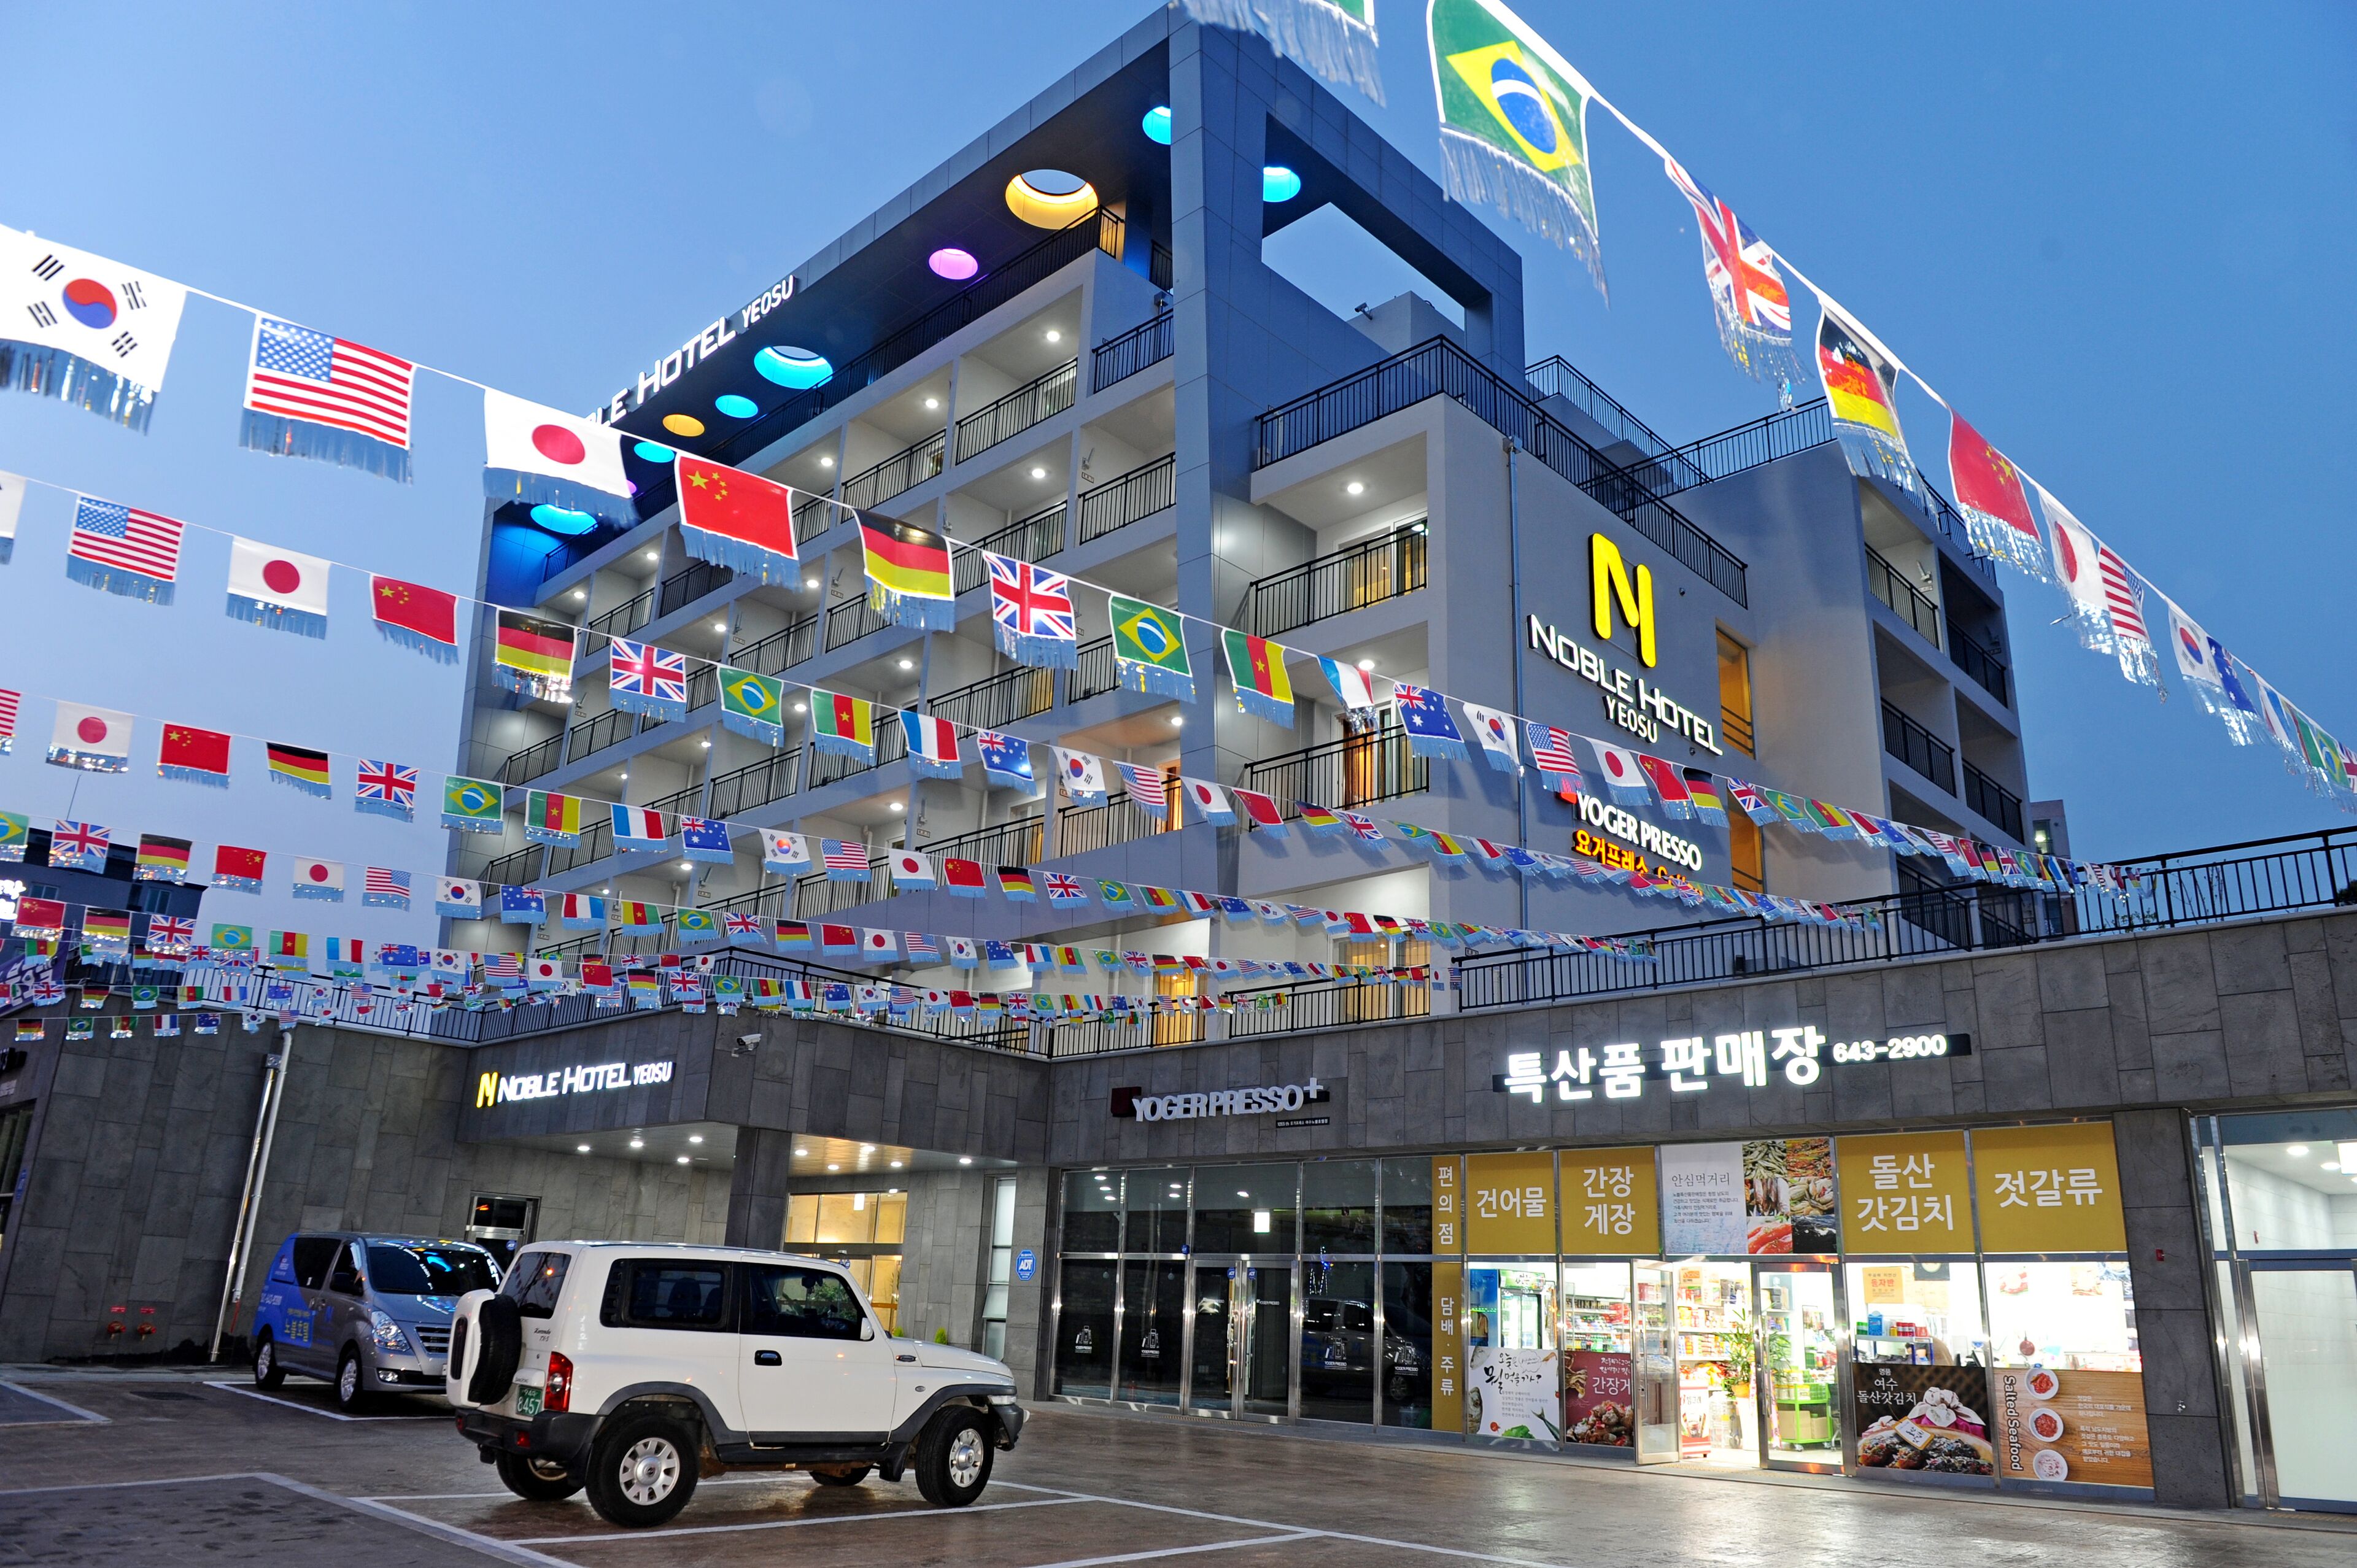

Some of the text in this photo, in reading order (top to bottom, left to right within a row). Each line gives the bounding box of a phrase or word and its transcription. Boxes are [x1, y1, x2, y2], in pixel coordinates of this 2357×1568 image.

[637, 315, 737, 404] HOTEL
[742, 274, 795, 328] YEOSU
[1528, 614, 1723, 755] NOBLE HOTEL
[1604, 695, 1658, 743] YEOSU
[1574, 829, 1649, 874] 요거프레소
[497, 1072, 561, 1103] NOBLE
[562, 1062, 632, 1095] HOTEL
[633, 1061, 673, 1086] YEOSU
[1504, 1025, 1948, 1103] 특산품 판매장 643-2900
[1583, 1166, 1634, 1197] 간장
[1671, 1172, 1730, 1187] 안심먹거리
[1869, 1153, 1935, 1190] 돌산
[1994, 1168, 2103, 1208] 젓갈류
[1438, 1167, 1453, 1245] 편의점
[1477, 1187, 1547, 1218] 건어물
[1584, 1203, 1636, 1235] 게장
[1857, 1194, 1954, 1232] 갓김치
[1019, 1259, 1033, 1270] ADT
[1499, 1353, 1518, 1370] 오늘은
[1504, 1372, 1542, 1386] 먹을까?
[1857, 1391, 1916, 1405] 돌산갓김치
[1874, 1378, 1898, 1391] 여수
[517, 1396, 541, 1415] 8457
[2003, 1375, 2024, 1470] Salted Seafood
